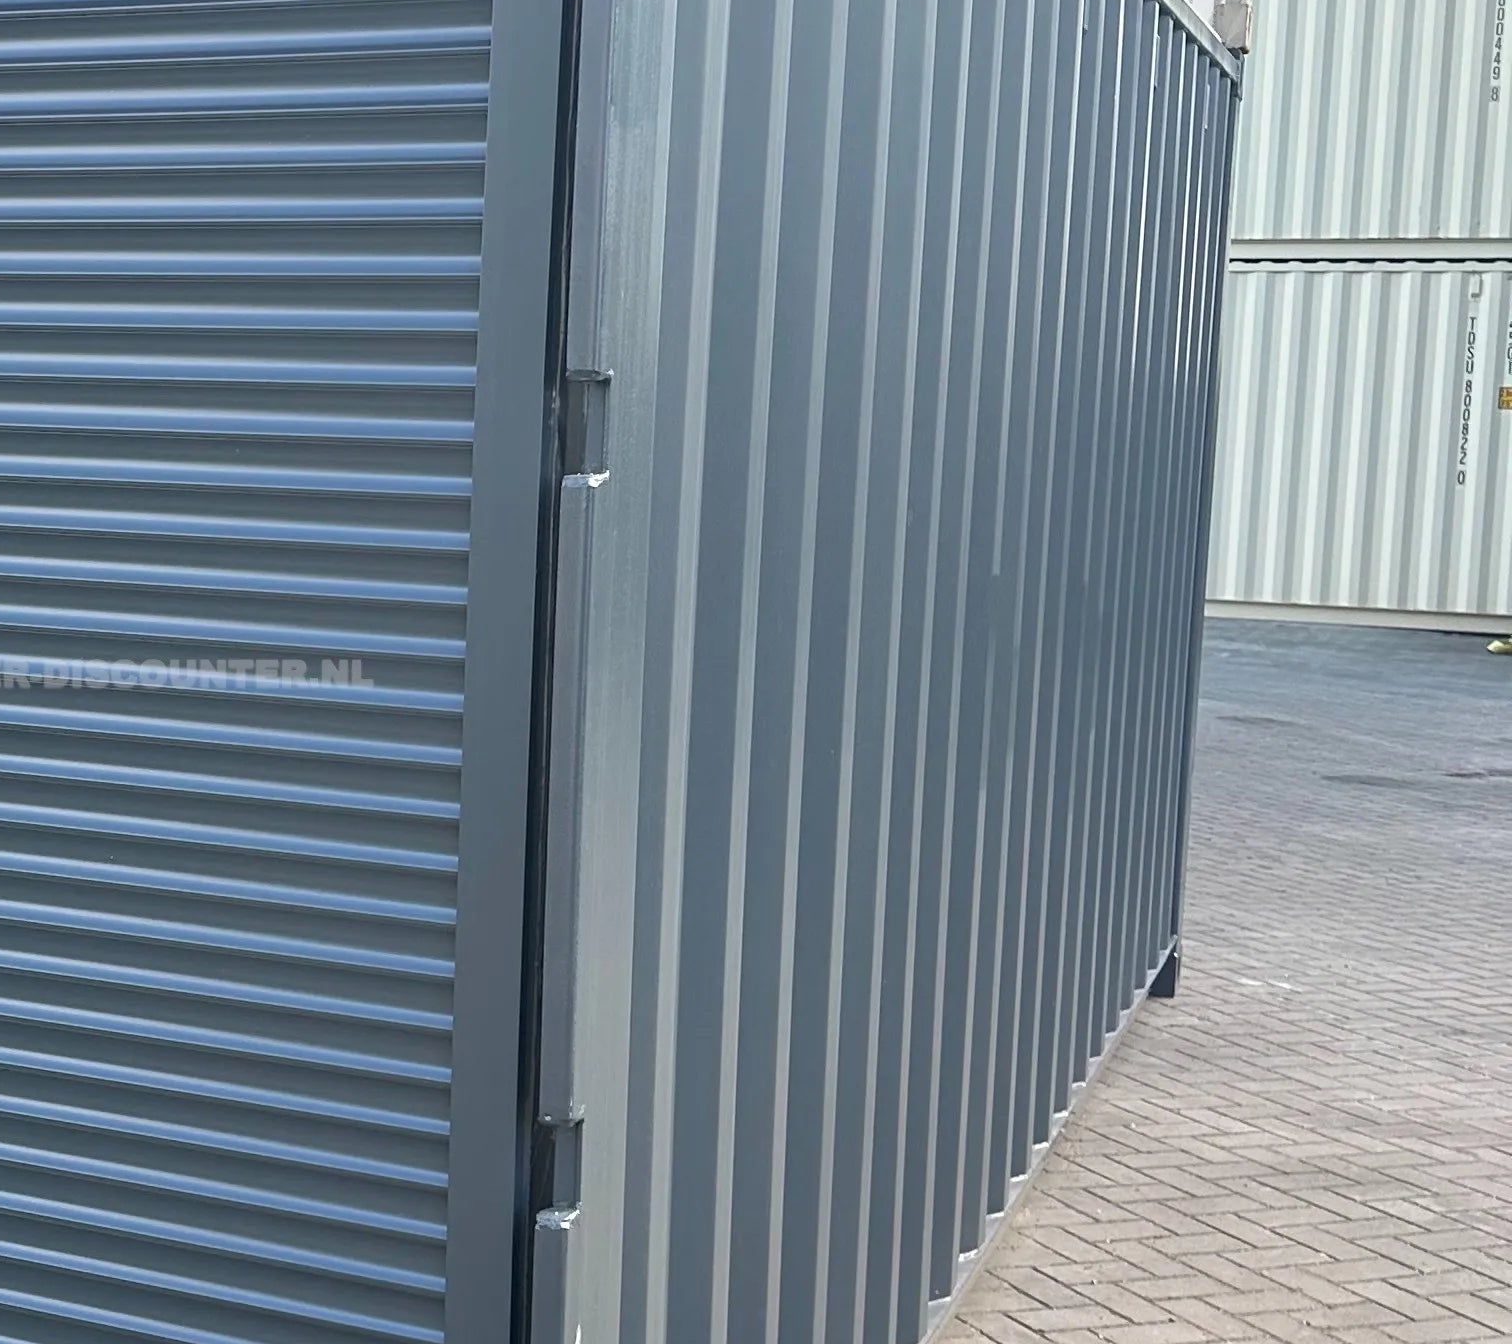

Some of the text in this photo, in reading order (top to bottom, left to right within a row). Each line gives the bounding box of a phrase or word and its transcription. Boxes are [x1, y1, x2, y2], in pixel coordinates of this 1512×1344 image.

[1490, 86, 1499, 102] 8
[1457, 316, 1477, 485] TDSU 800822 0
